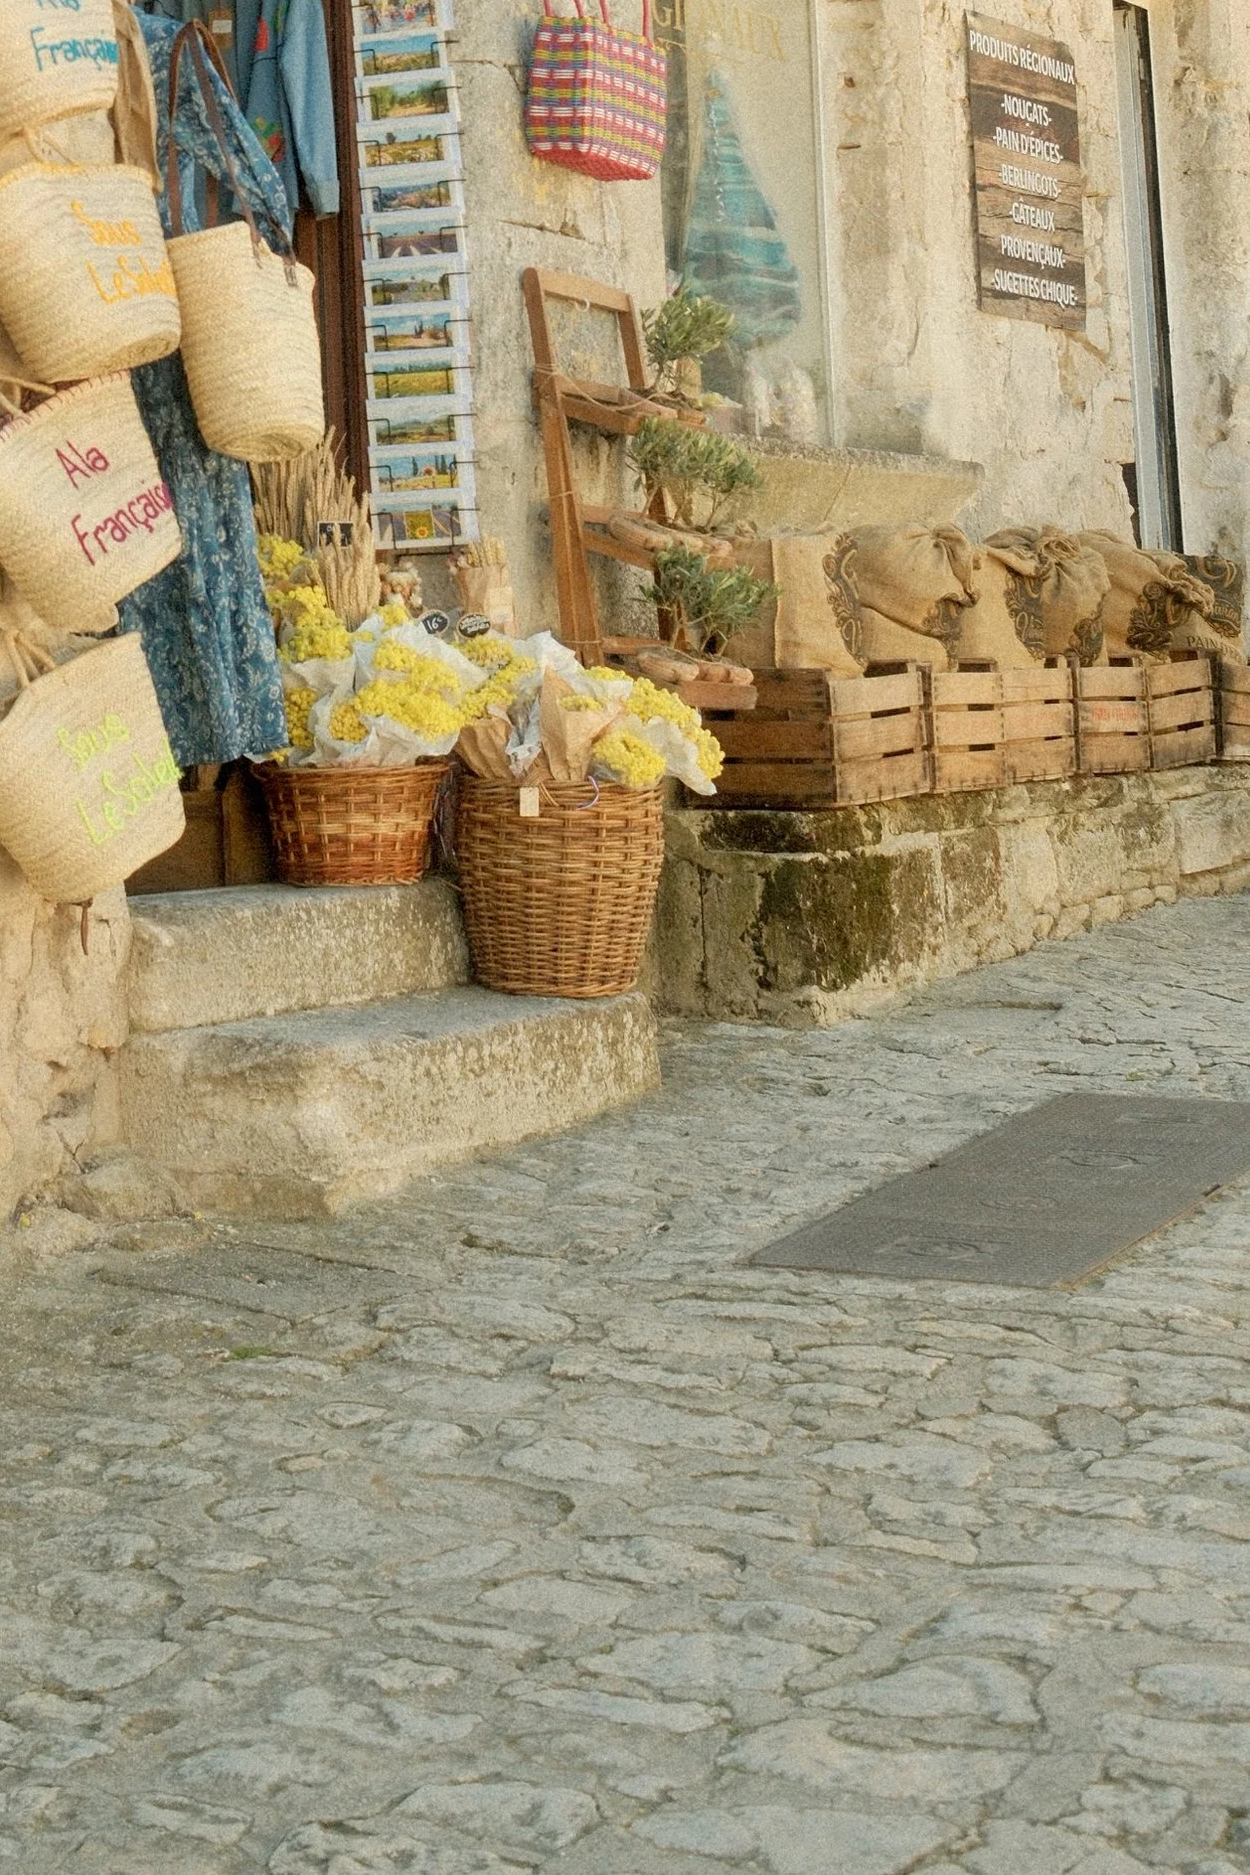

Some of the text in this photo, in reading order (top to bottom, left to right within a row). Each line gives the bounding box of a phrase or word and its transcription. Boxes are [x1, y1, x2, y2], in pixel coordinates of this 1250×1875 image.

[969, 29, 1075, 85] PRODUITS RÉGIONAUX
[71, 479, 173, 566] Français
